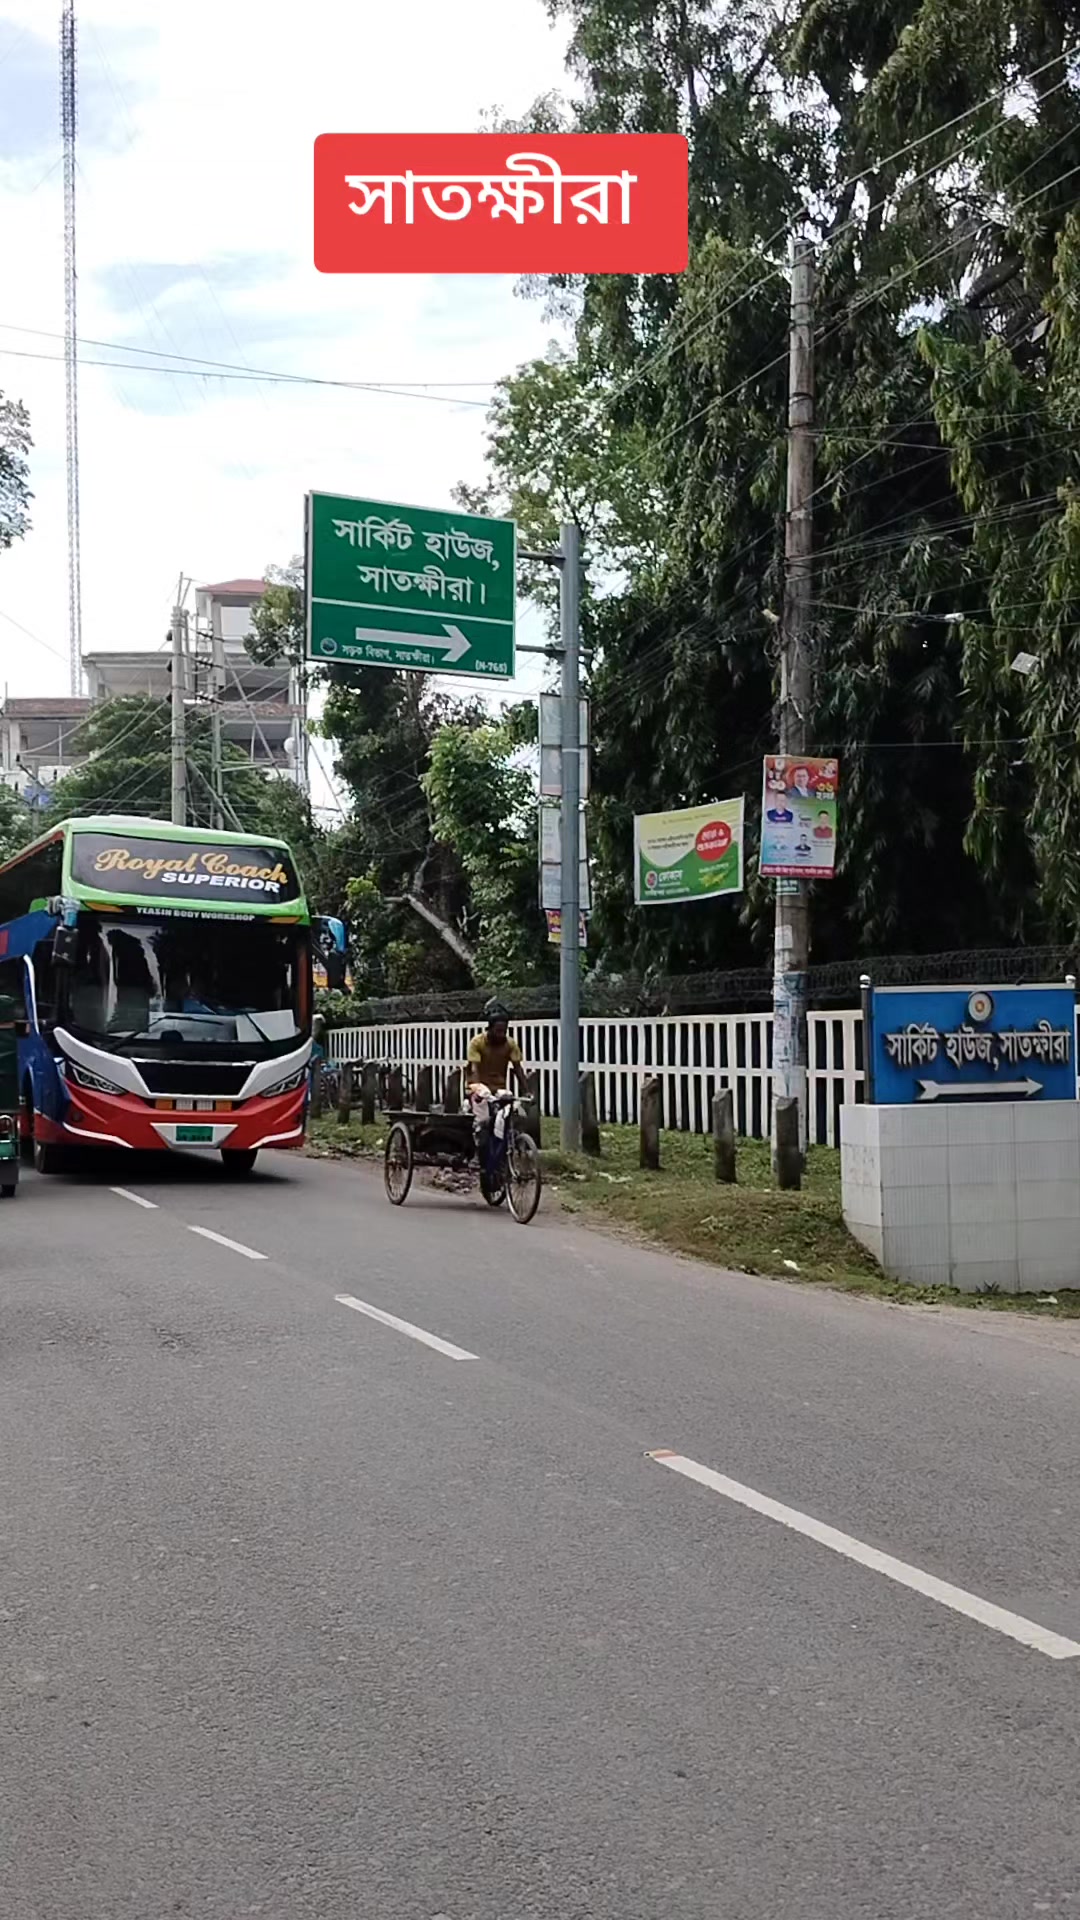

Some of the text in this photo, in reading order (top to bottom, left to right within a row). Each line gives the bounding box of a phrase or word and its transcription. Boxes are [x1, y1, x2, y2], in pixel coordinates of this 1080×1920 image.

[332, 515, 500, 572] সার্কিট হাউজ,
[341, 644, 363, 657] সড়ক
[475, 659, 508, 674] (N-765)
[94, 849, 289, 885] Royal Coach
[161, 872, 281, 894] SUPERIOR
[136, 906, 256, 922] YEASIN BODY WORKSHOP
[885, 1022, 940, 1067] সার্কিট
